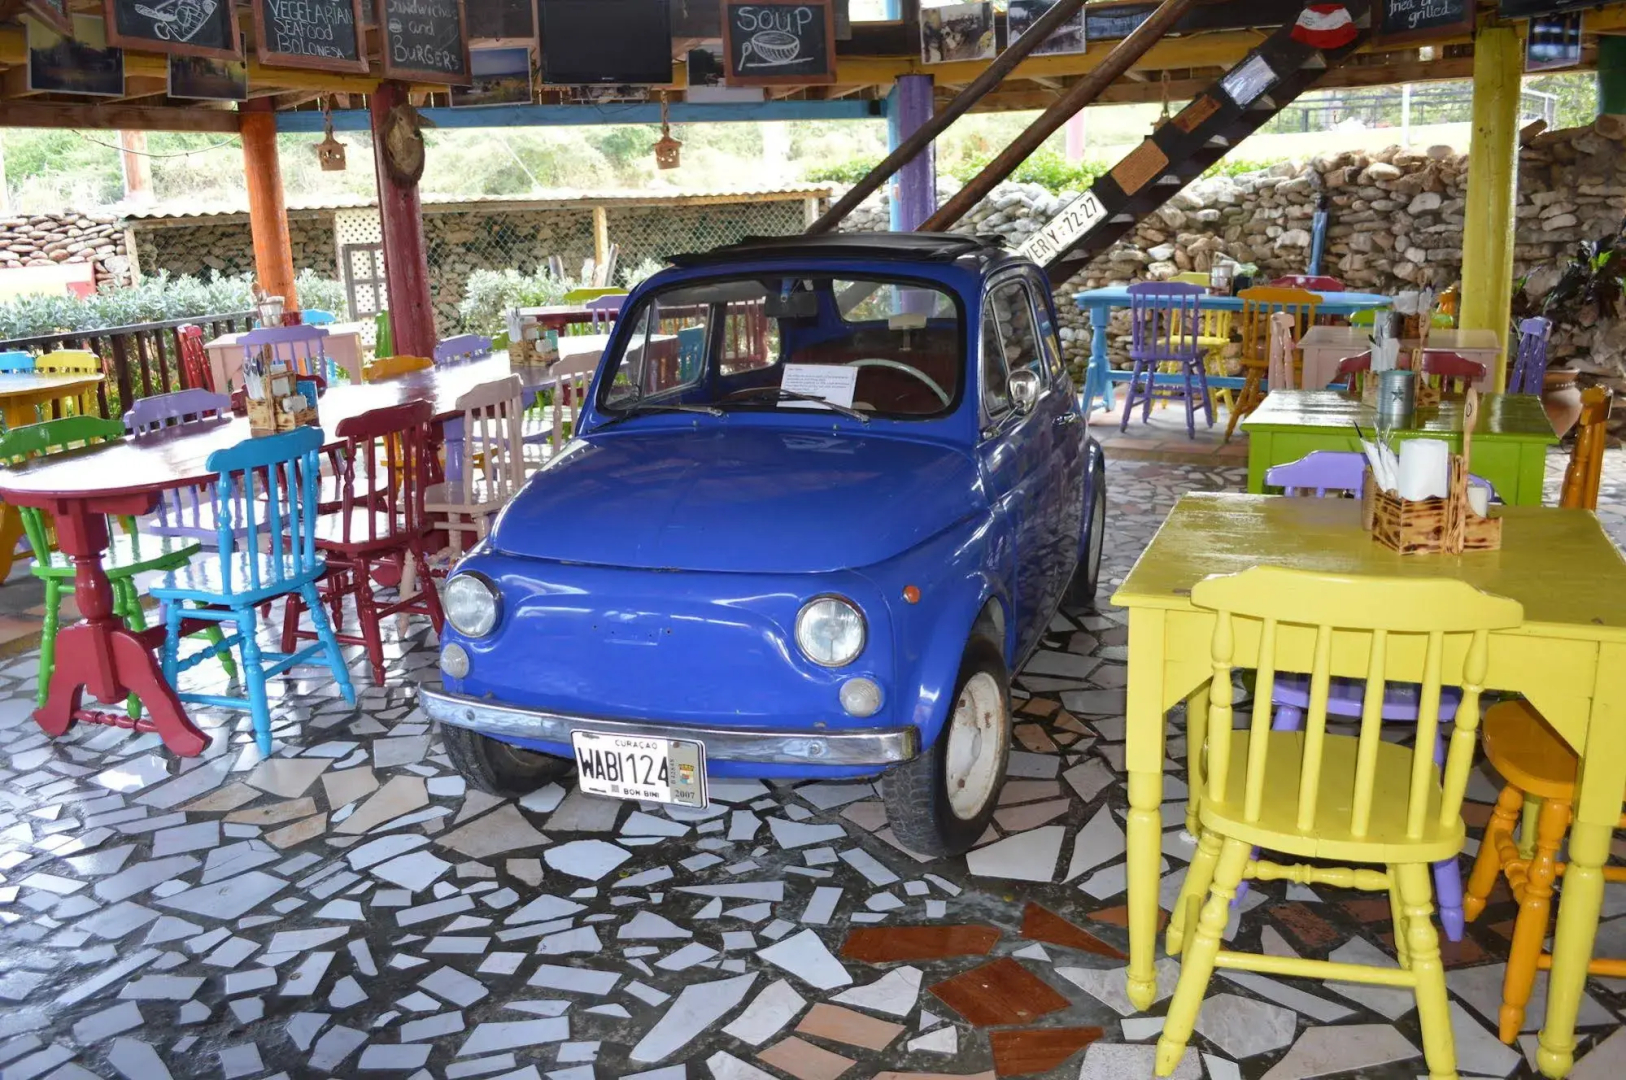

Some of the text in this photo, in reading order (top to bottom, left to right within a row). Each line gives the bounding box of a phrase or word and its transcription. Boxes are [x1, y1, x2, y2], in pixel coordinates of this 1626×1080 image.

[409, 20, 435, 36] and
[737, 6, 812, 35] SOUP
[1408, 1, 1450, 28] grilled
